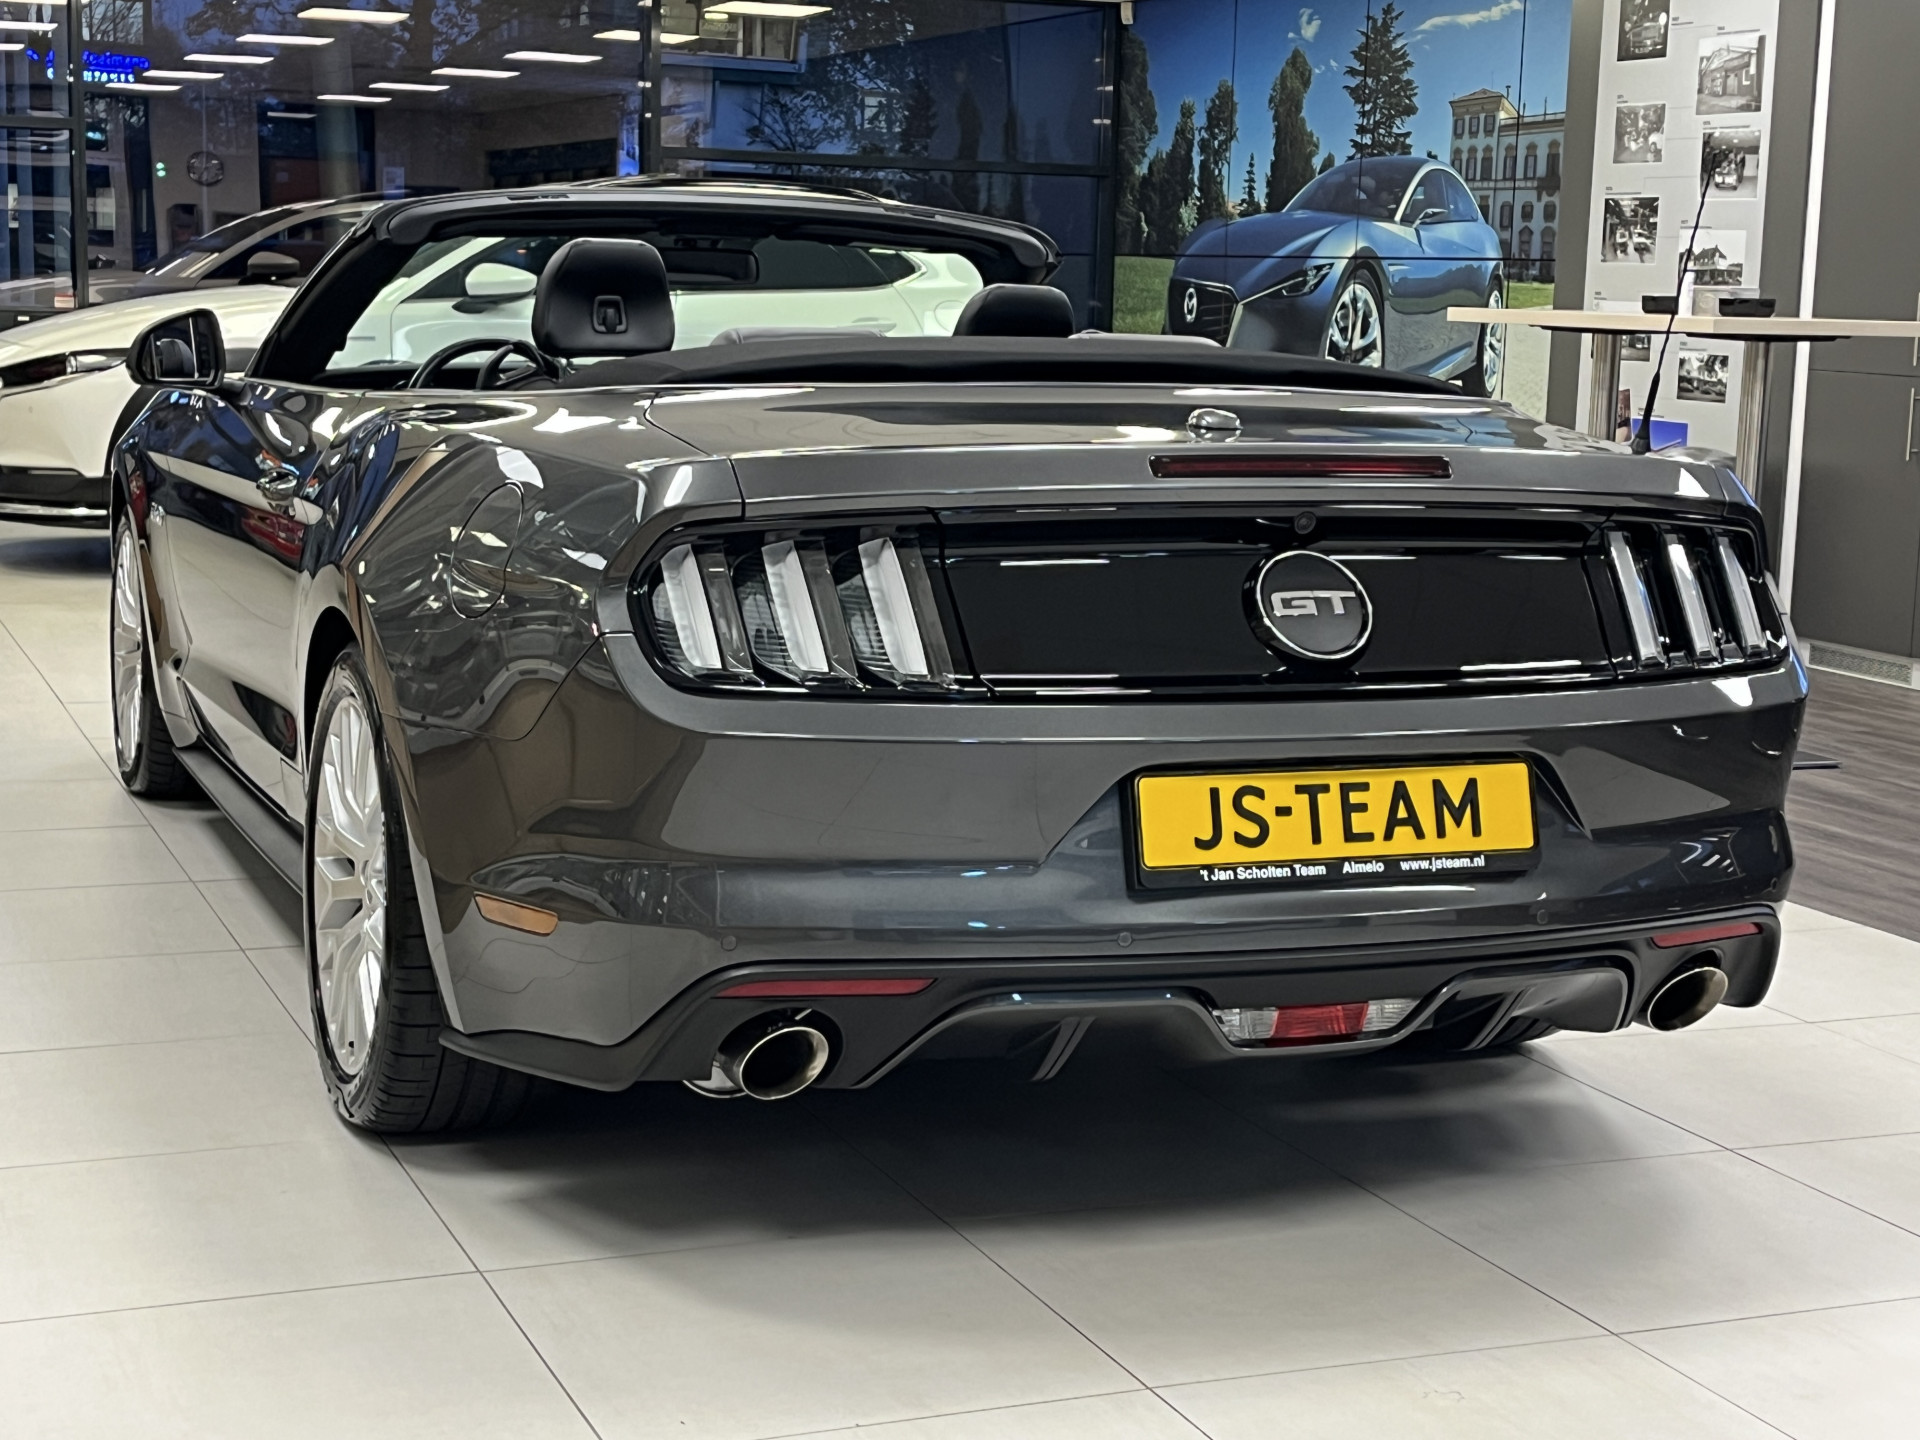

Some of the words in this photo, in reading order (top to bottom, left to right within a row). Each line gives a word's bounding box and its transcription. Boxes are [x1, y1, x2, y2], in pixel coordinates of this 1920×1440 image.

[1271, 590, 1356, 617] GT
[1194, 777, 1482, 851] JS-TEAM
[1211, 868, 1235, 881] Jan
[1236, 865, 1291, 880] Scholten
[1293, 863, 1327, 877] Team
[1342, 859, 1385, 874] Almelo
[1400, 854, 1486, 872] www.jsteam.nl
